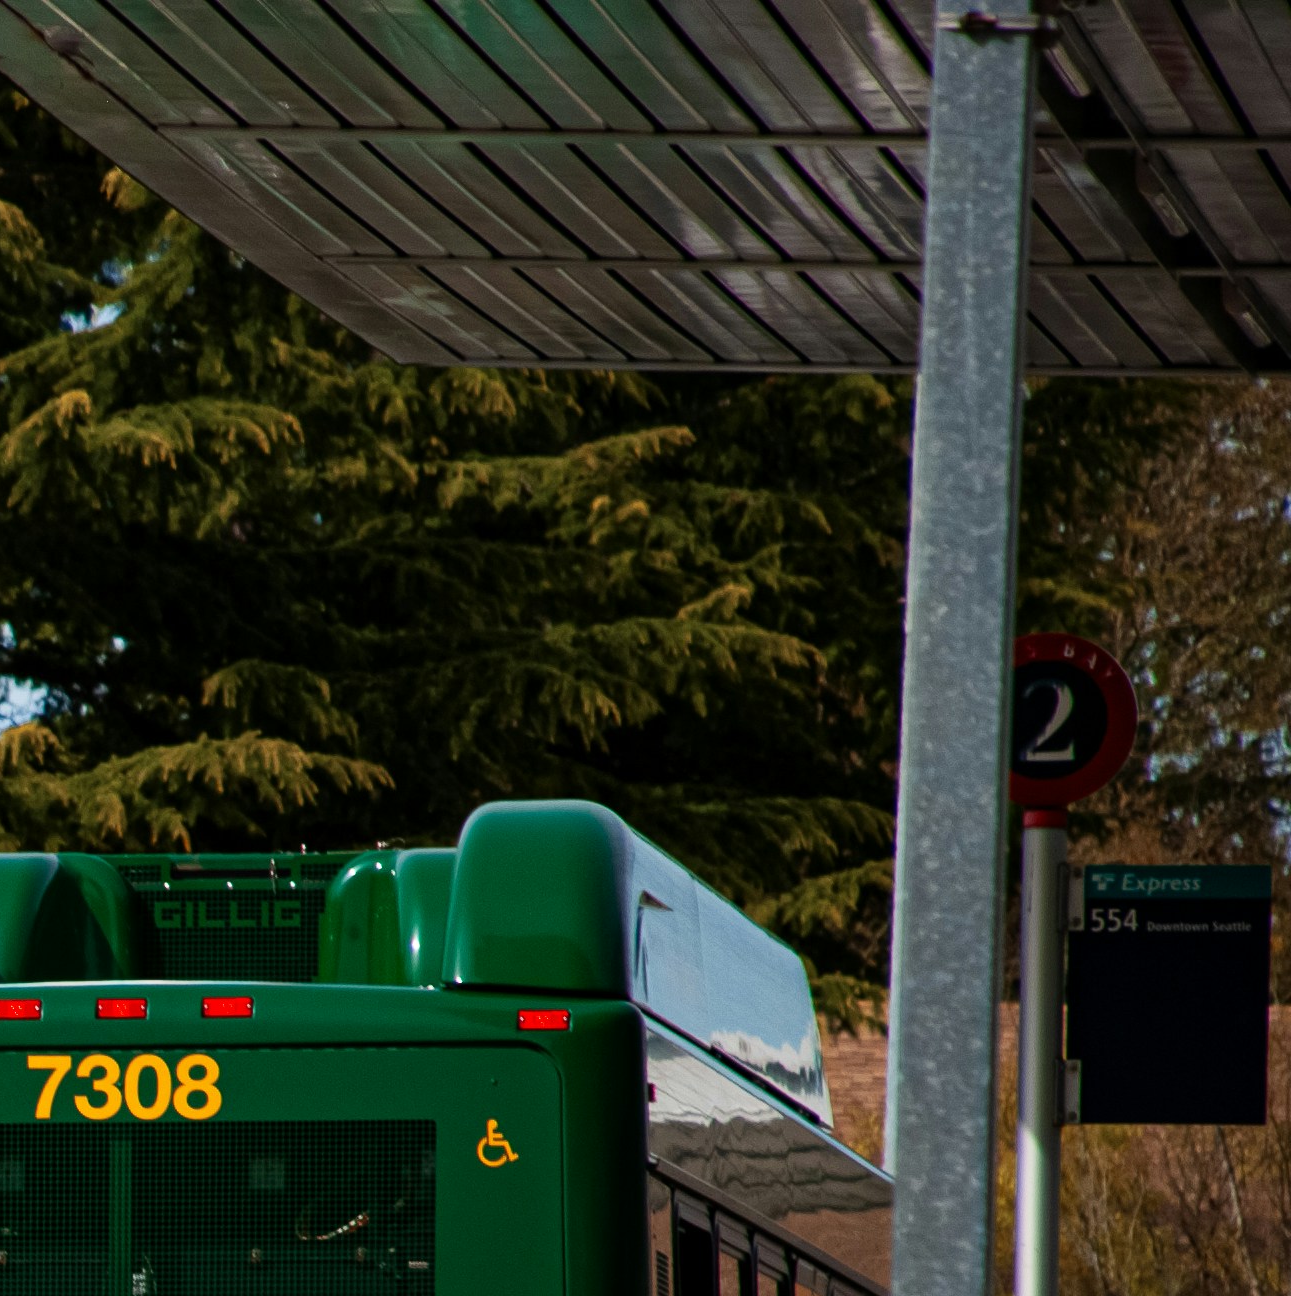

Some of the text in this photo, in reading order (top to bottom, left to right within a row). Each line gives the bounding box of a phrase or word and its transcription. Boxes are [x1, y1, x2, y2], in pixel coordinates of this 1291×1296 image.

[1021, 678, 1075, 762] 2
[1121, 873, 1202, 897] Express
[155, 900, 301, 929] GILLIG
[1090, 907, 1253, 933] 554 Downtown Seattle
[27, 1053, 223, 1121] 7308
